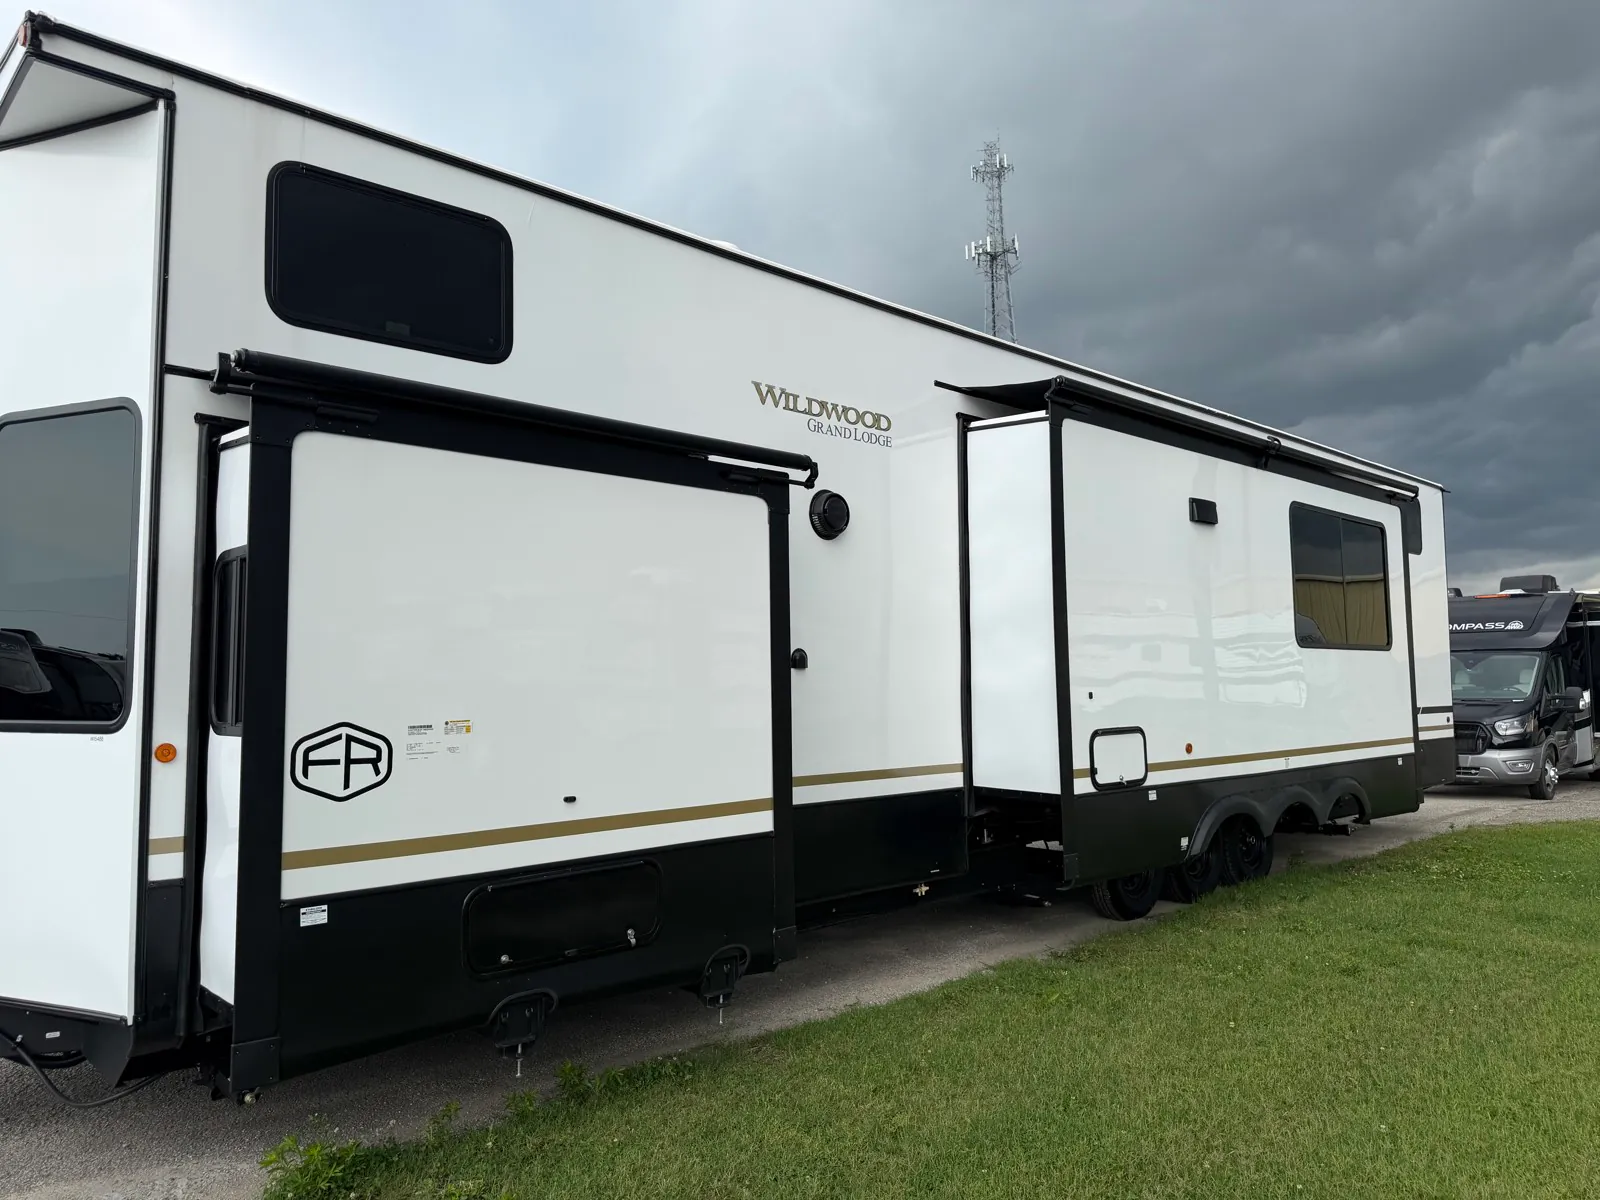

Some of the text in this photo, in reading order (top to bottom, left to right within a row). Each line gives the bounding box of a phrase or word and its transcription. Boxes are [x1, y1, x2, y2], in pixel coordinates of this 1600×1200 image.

[751, 380, 892, 432] WILDWOOD
[807, 418, 893, 448] GRAND LODGE
